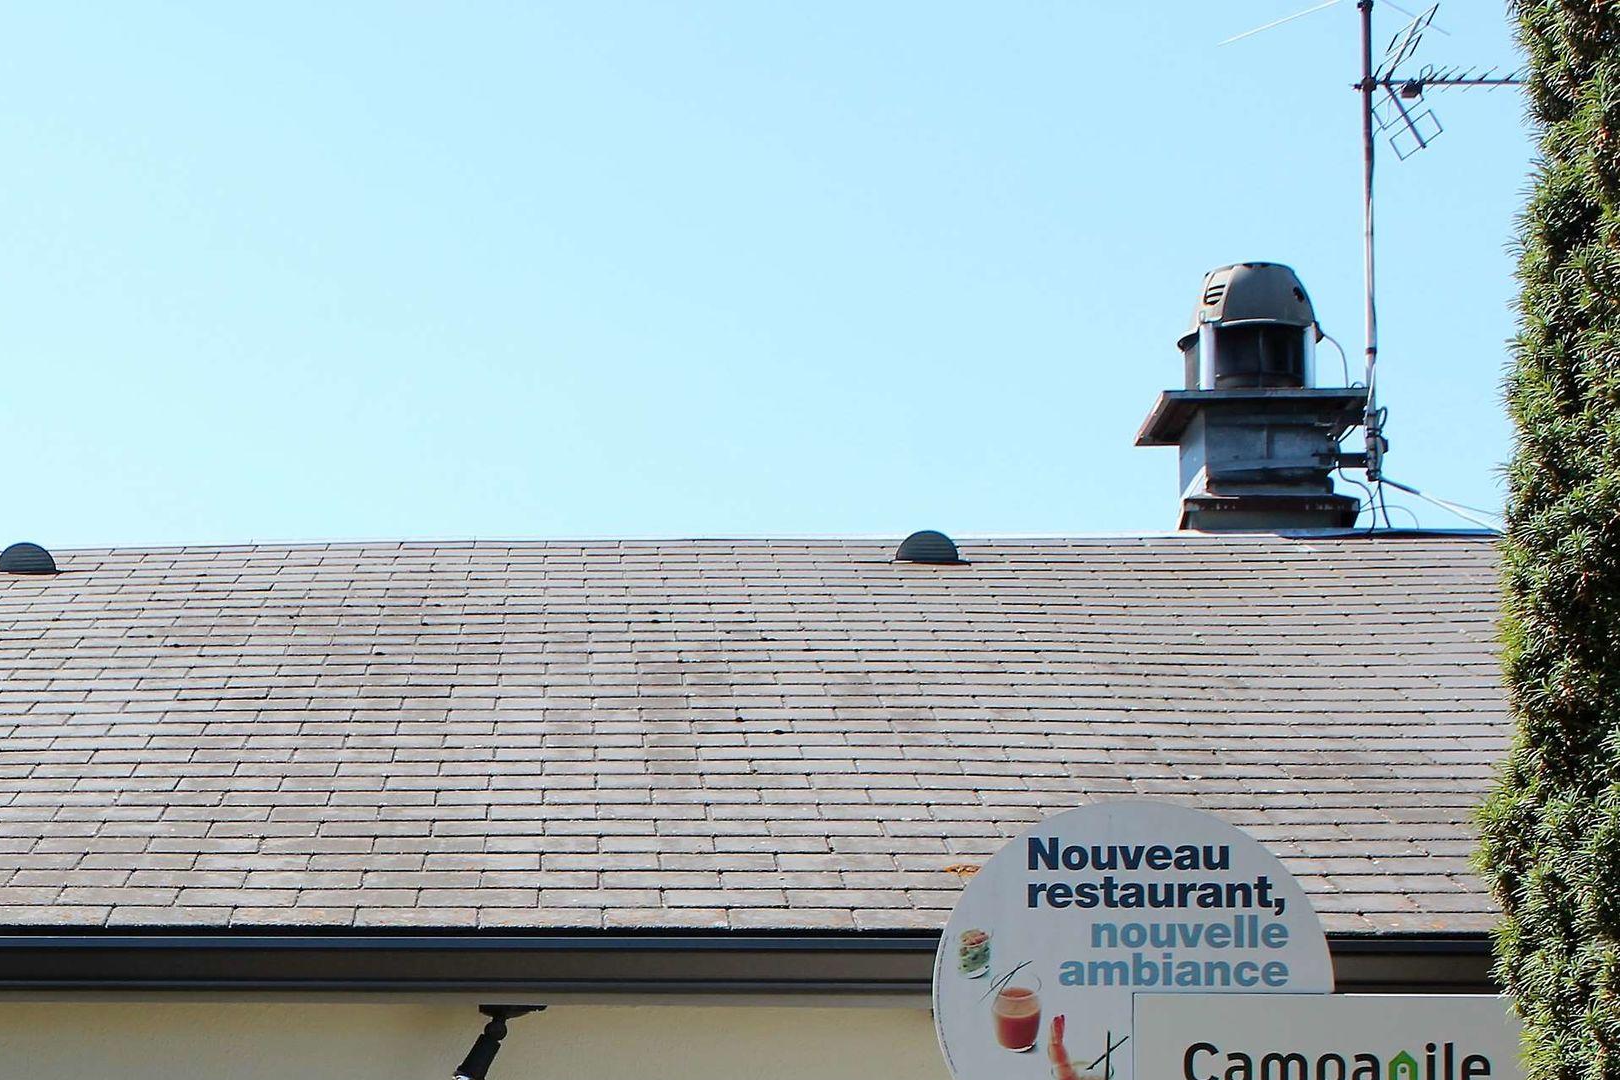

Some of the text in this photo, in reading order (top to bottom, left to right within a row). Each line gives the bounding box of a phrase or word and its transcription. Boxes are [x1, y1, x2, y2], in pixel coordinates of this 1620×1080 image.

[1027, 837, 1230, 870] Nouveau
[1027, 875, 1285, 916] restaurant,
[1091, 915, 1289, 949] nouvelle
[1058, 953, 1289, 987] ambiance
